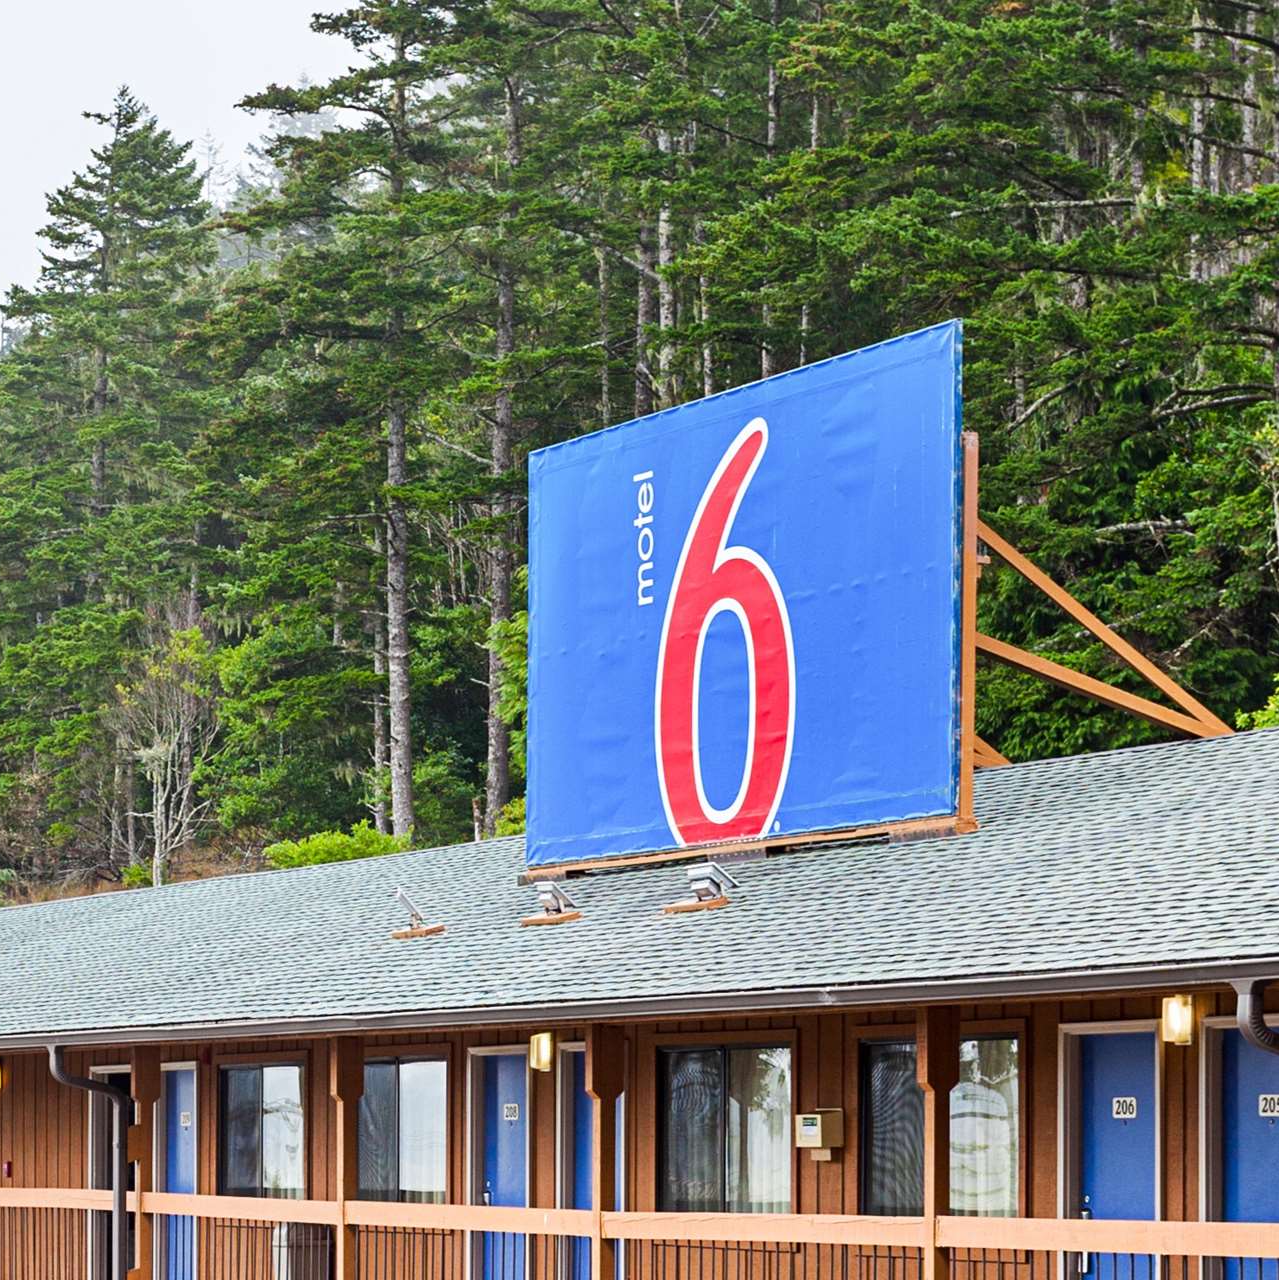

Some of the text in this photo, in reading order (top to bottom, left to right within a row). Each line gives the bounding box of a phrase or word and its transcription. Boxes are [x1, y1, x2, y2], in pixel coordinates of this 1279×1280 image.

[633, 470, 654, 606] motel
[654, 416, 797, 848] 6
[505, 1105, 517, 1119] 208
[1115, 1100, 1135, 1115] 206
